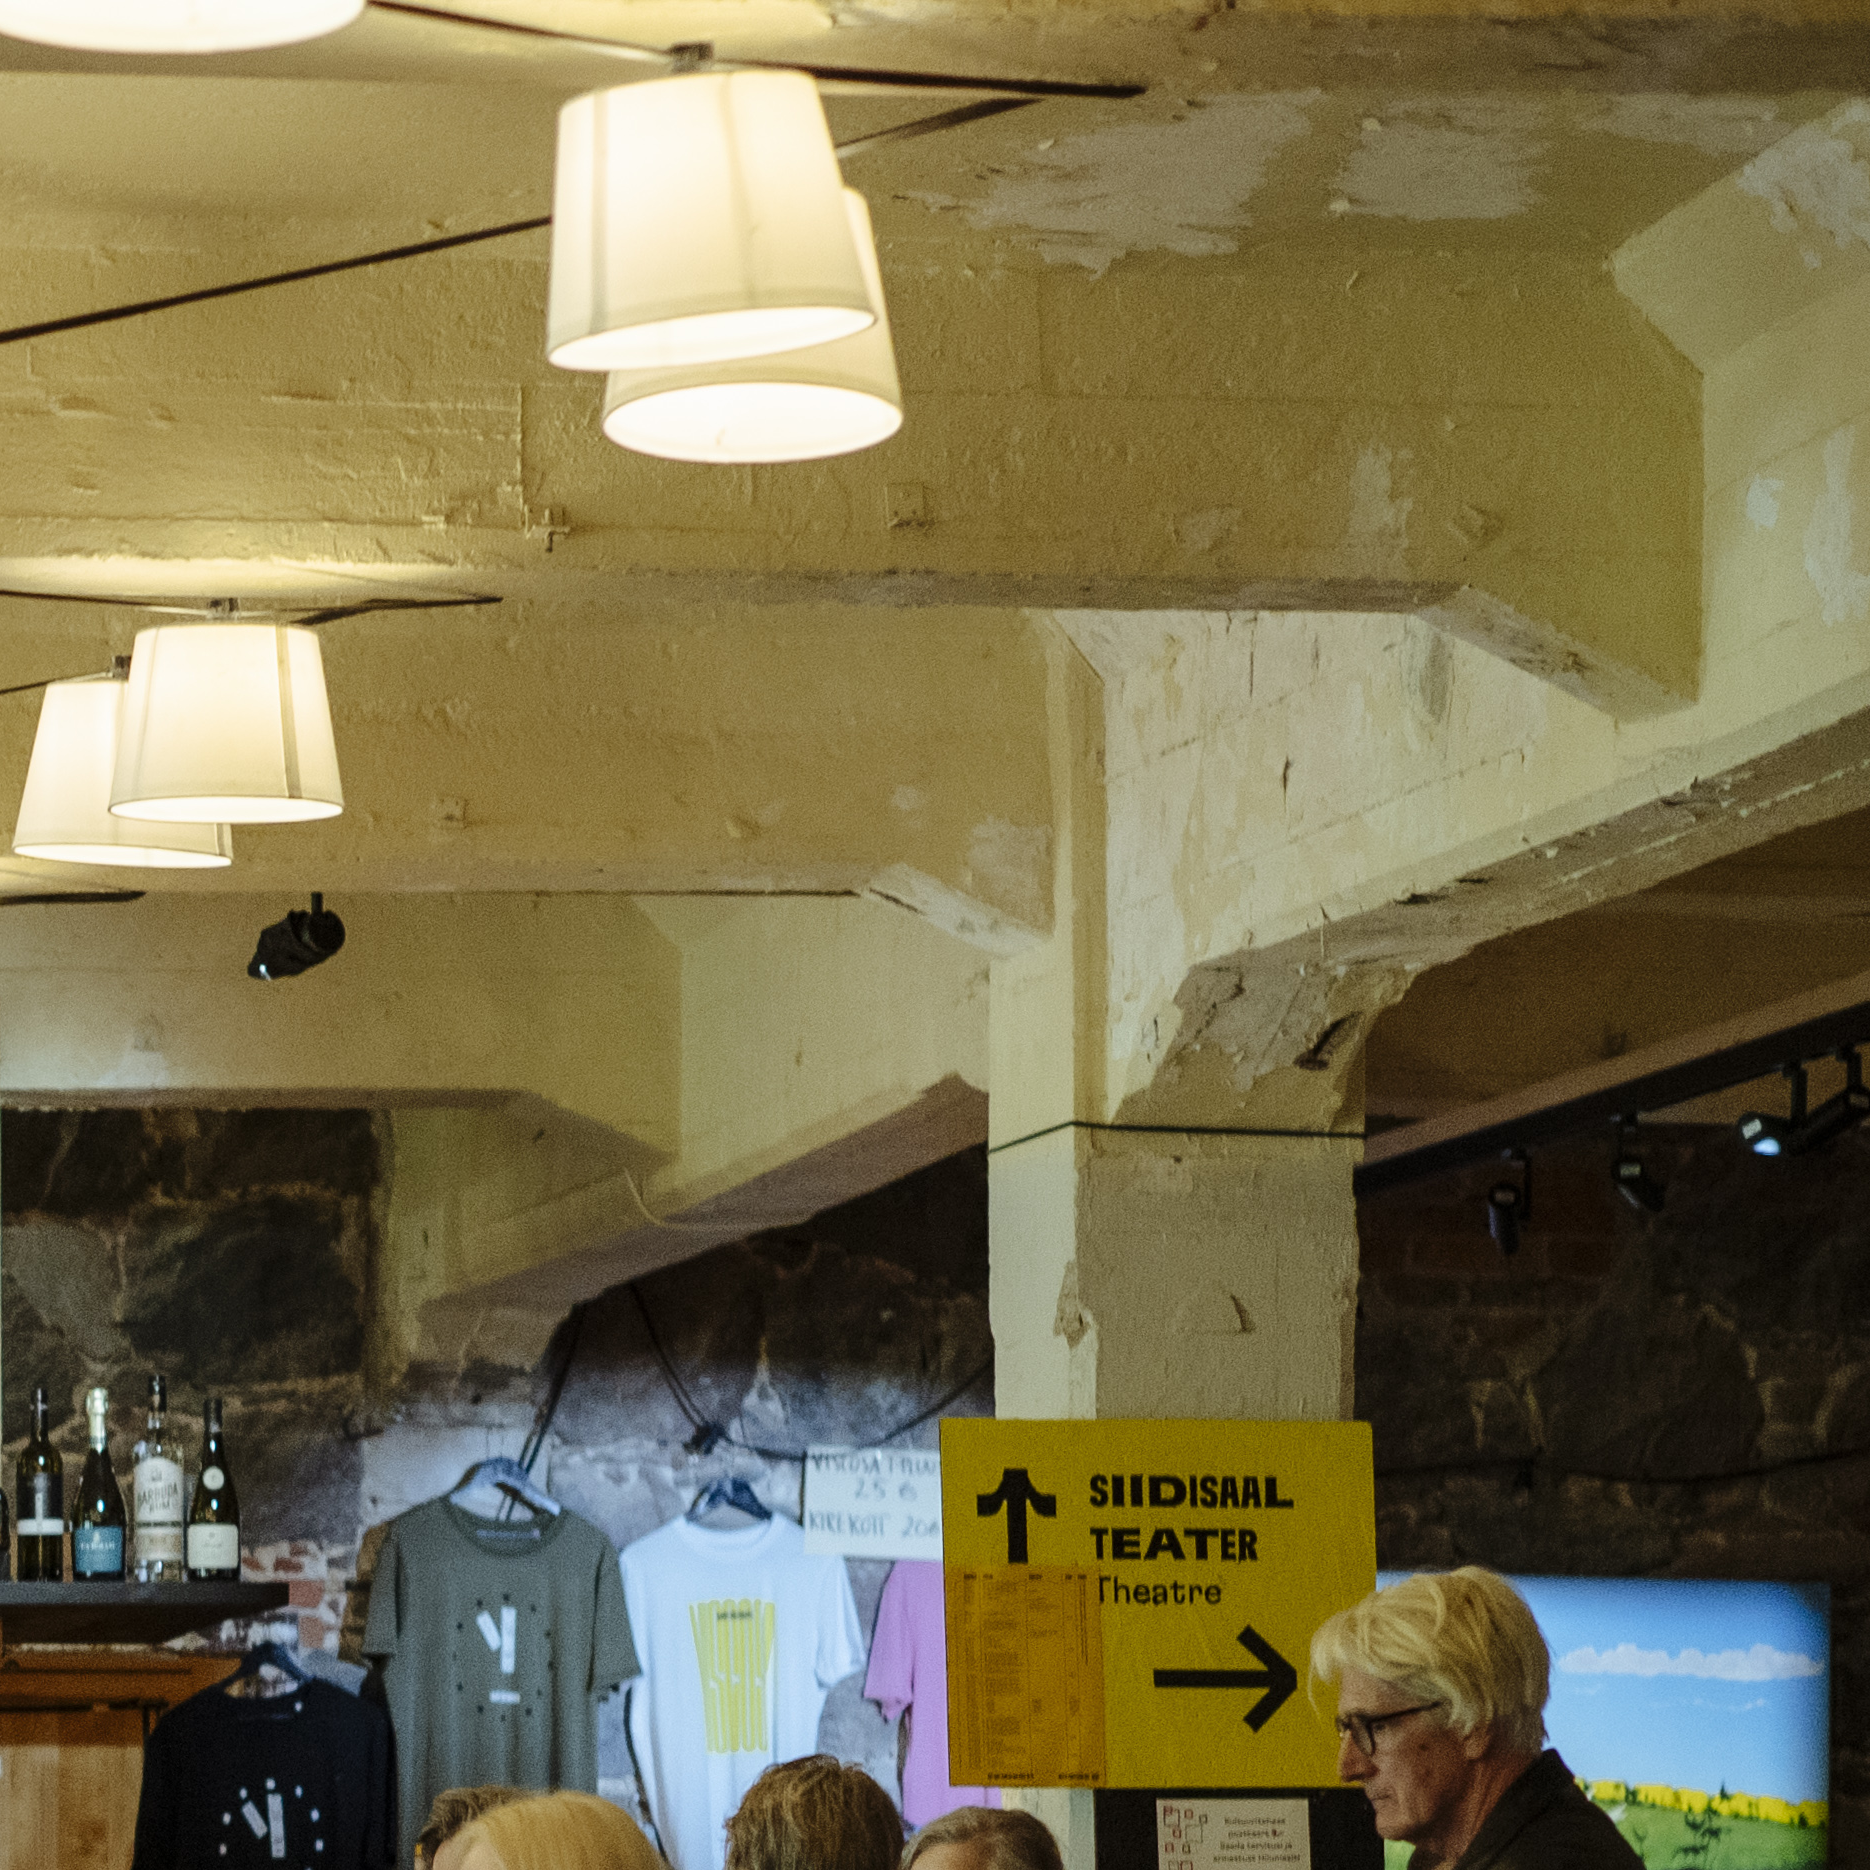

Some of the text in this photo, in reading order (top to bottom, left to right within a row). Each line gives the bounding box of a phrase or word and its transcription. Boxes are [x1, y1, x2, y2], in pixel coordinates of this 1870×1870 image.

[1089, 1473, 1295, 1509] SIIDISAAL
[1089, 1526, 1259, 1564] TEATER
[1097, 1576, 1222, 1606] Theatre
